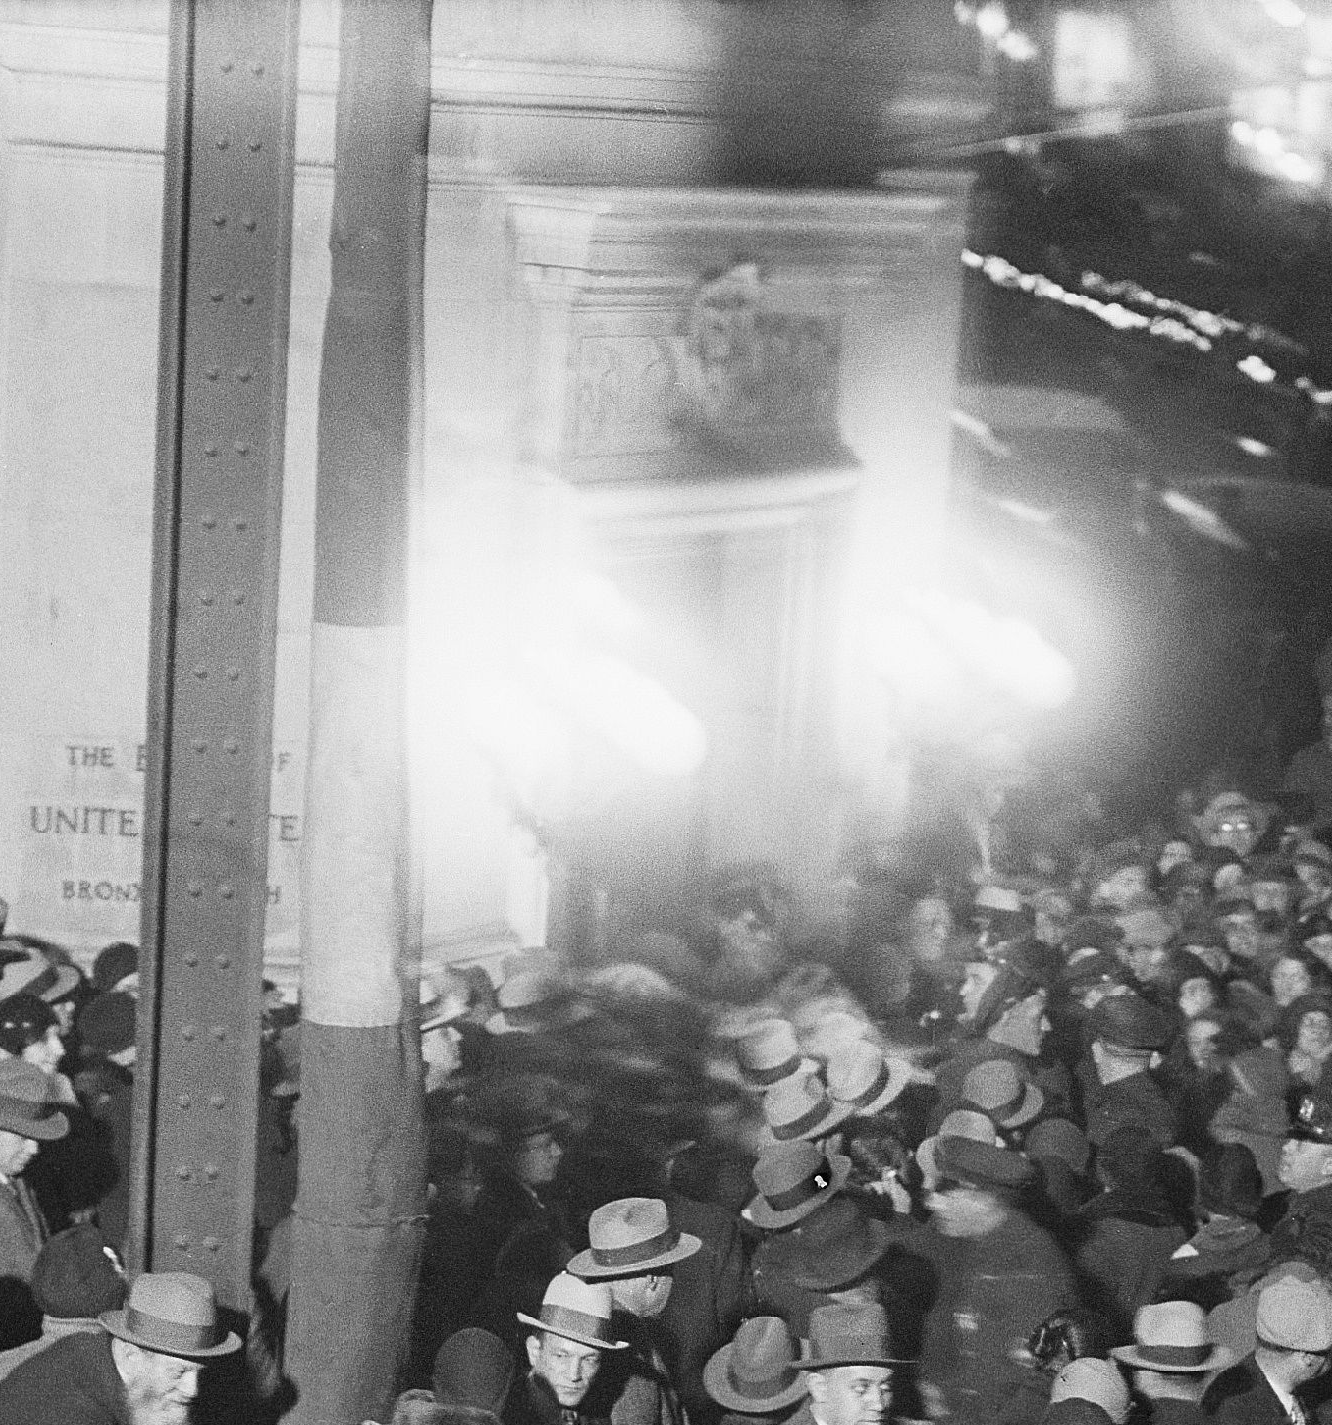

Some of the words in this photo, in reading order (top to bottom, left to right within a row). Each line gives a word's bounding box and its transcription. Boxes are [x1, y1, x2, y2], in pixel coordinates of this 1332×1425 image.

[67, 745, 115, 767] THE
[30, 805, 140, 837] UNITE
[62, 880, 143, 902] BRON
